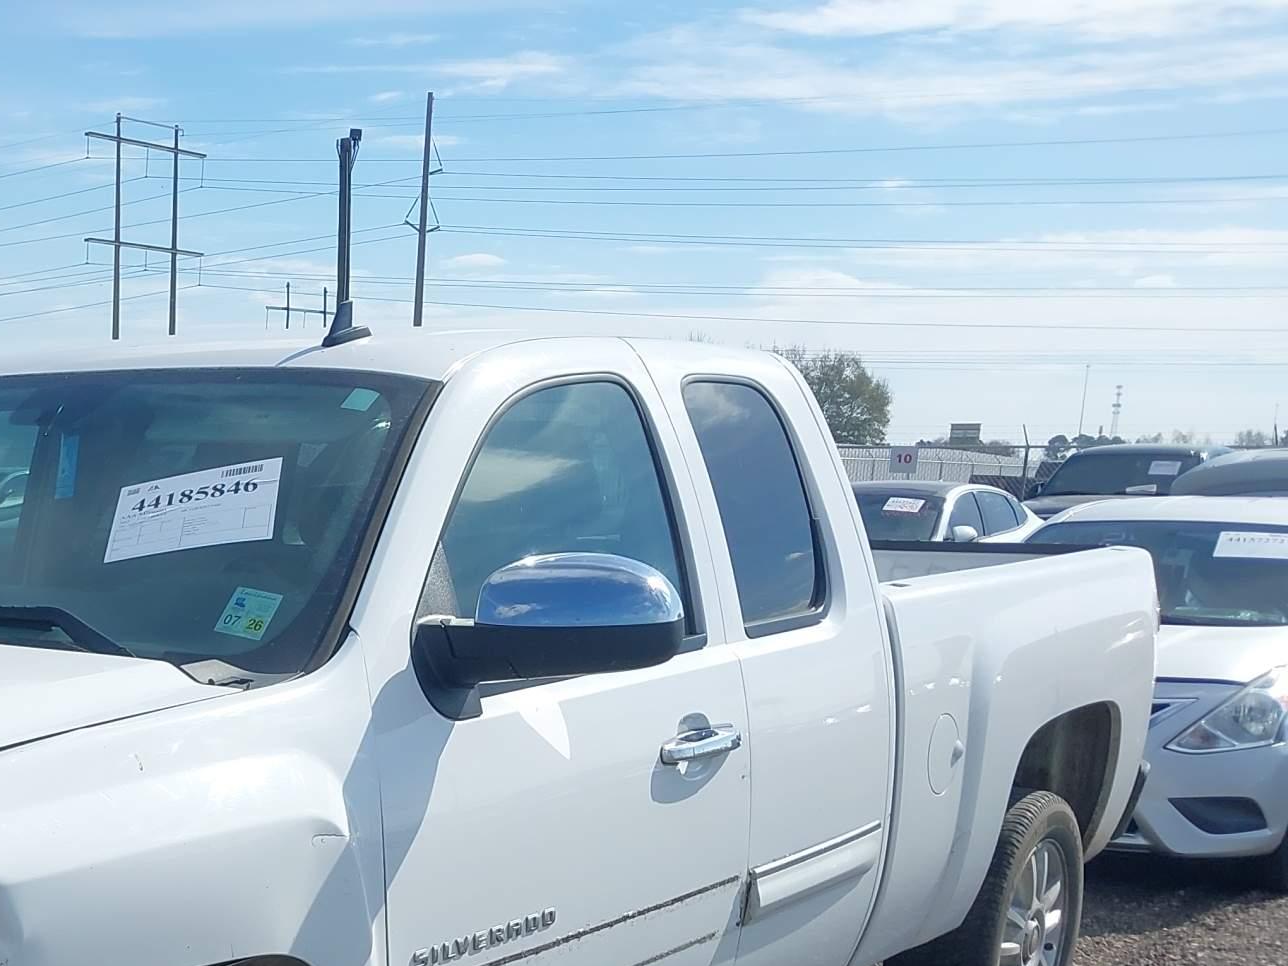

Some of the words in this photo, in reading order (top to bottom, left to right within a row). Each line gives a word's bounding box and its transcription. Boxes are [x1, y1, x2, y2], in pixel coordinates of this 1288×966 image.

[896, 453, 913, 464] 10
[132, 477, 259, 512] 44185846
[223, 614, 242, 626] 07
[245, 617, 264, 632] 26
